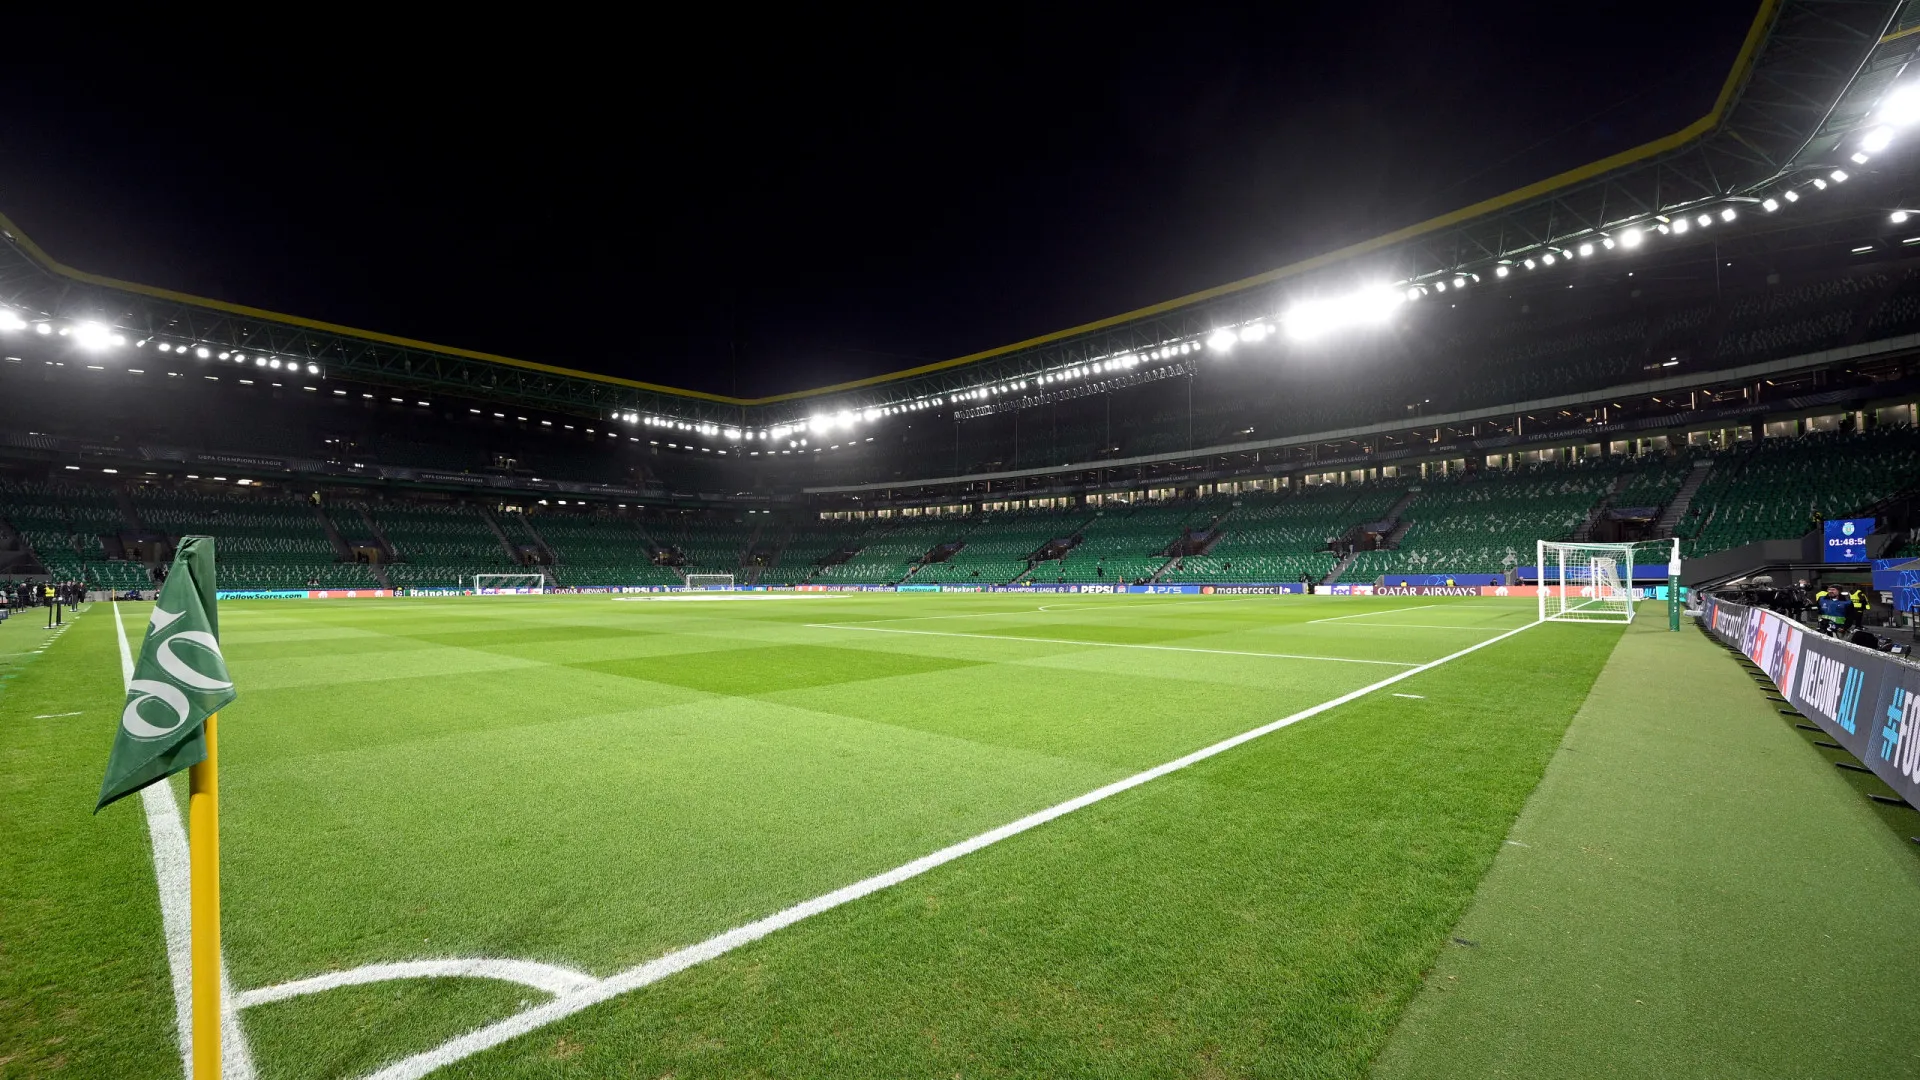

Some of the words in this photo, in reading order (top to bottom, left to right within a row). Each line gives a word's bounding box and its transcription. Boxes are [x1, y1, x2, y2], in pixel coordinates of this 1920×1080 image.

[1548, 427, 1593, 439] CHAMPIONS
[1595, 424, 1625, 433] LEAGUE
[217, 455, 257, 464] CHAMPIONS
[555, 587, 579, 595] QATAR
[1081, 586, 1114, 594] PEPSI
[1377, 586, 1417, 596] QATAR
[1423, 586, 1477, 596] AIRWAYS
[1799, 648, 1846, 722] WELCOME
[1836, 666, 1865, 735] ALL
